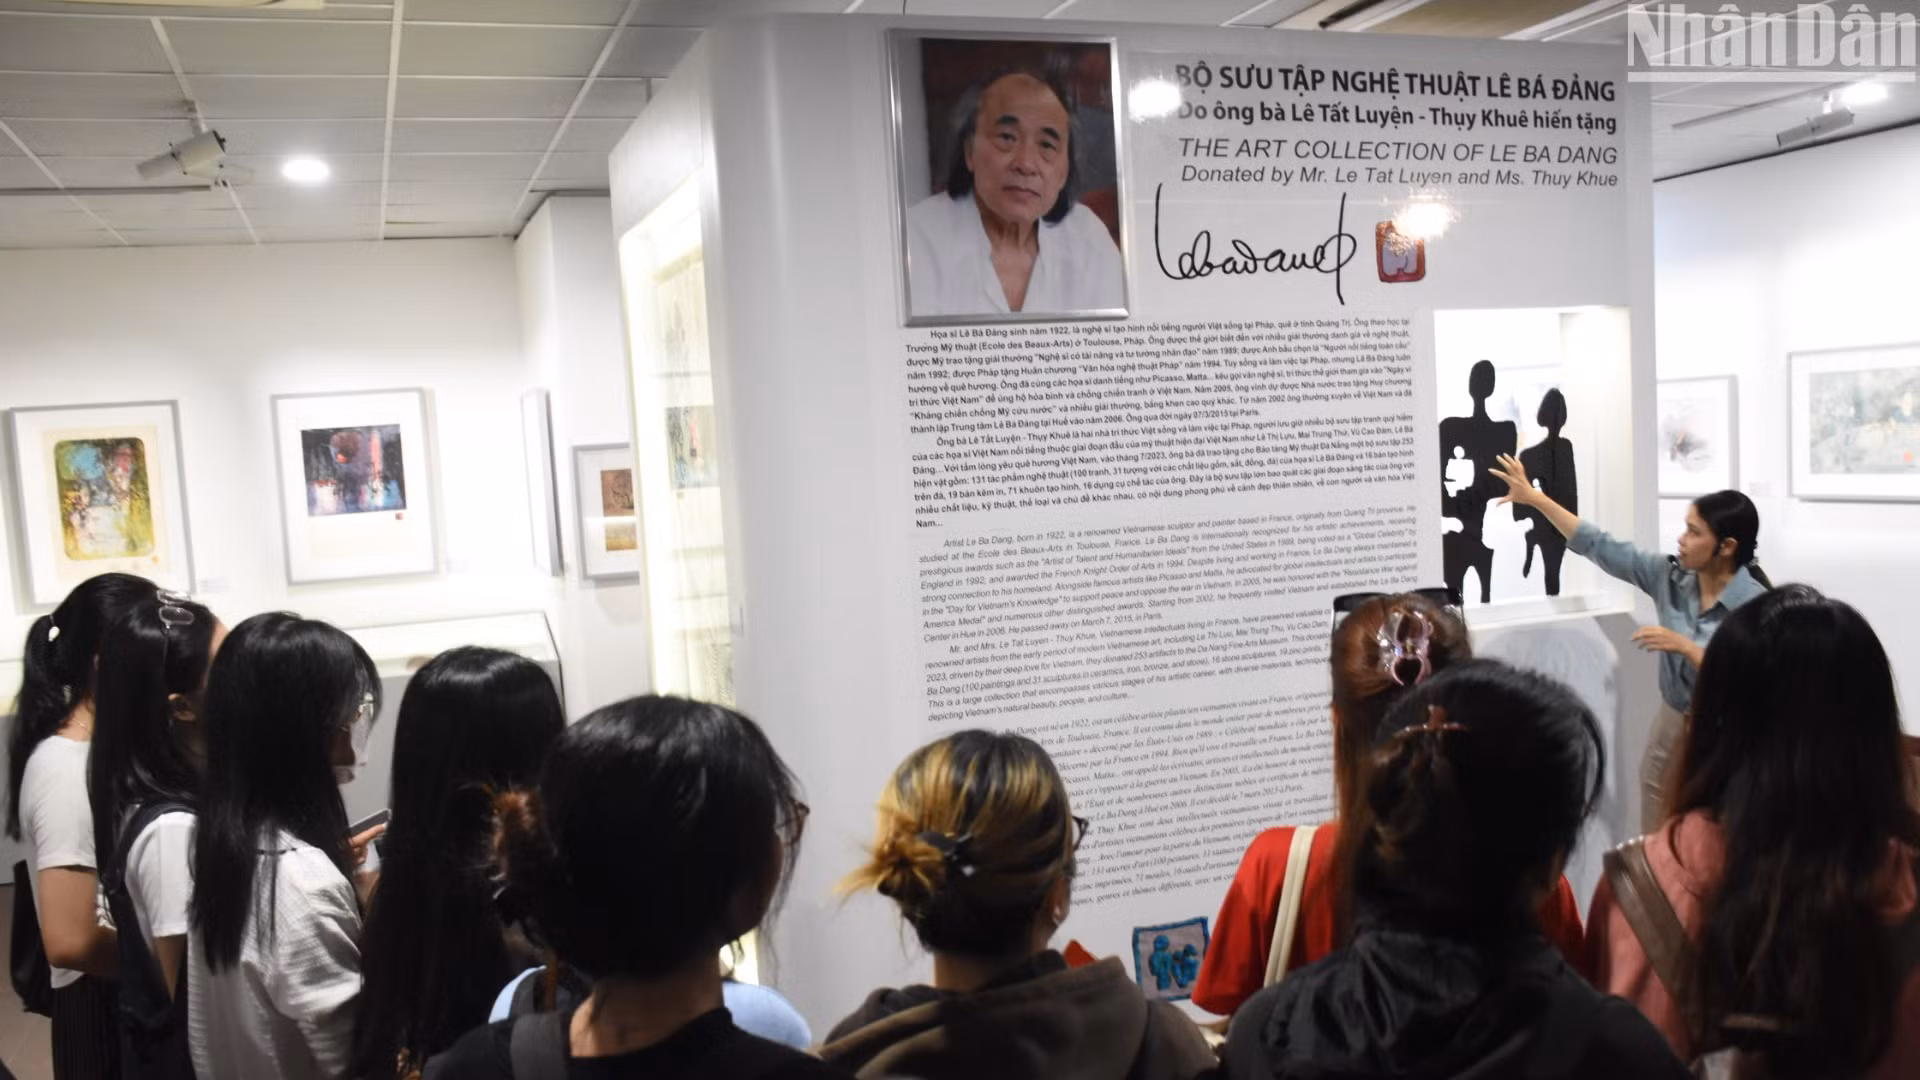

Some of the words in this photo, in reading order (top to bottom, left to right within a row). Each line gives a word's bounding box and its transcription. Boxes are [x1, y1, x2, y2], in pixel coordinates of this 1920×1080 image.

[1175, 59, 1213, 95] BỘ
[1219, 63, 1273, 90] SƯU
[1277, 63, 1326, 97] TẬP
[1331, 67, 1401, 101] NGHỆ
[1403, 70, 1481, 103] THUẬT
[1486, 72, 1512, 98] LÊ
[1517, 73, 1547, 100] BÁ
[1551, 72, 1615, 102] ĐẢNG
[1212, 100, 1255, 126] ông
[1259, 101, 1286, 122] bà
[1291, 102, 1315, 123] Lê
[1317, 101, 1350, 123] Tất
[1354, 104, 1414, 129] Luyện
[1428, 106, 1477, 131] Thụy
[1481, 108, 1529, 128] Khuê
[1532, 108, 1572, 129] hiến
[1576, 112, 1617, 136] tặng
[1178, 137, 1230, 158] THE
[1234, 138, 1288, 158] ART
[1294, 139, 1447, 161] COLLECTION
[1453, 143, 1485, 162] OF
[1489, 143, 1518, 163] LE
[1522, 144, 1551, 164] BA
[1557, 145, 1618, 165] DANG
[1181, 164, 1266, 183] Donated
[1270, 165, 1295, 187] by
[1299, 166, 1329, 183] Mr.
[1334, 166, 1358, 183] Le
[1364, 166, 1394, 184] Tat
[1398, 167, 1453, 188] Luyen
[1457, 168, 1491, 185] and
[1495, 169, 1527, 186] Ms.
[1531, 169, 1572, 190] Thuy
[1576, 170, 1619, 187] Khue
[910, 424, 935, 433] thành
[952, 423, 976, 432] Trung
[916, 520, 944, 528] Nam...
